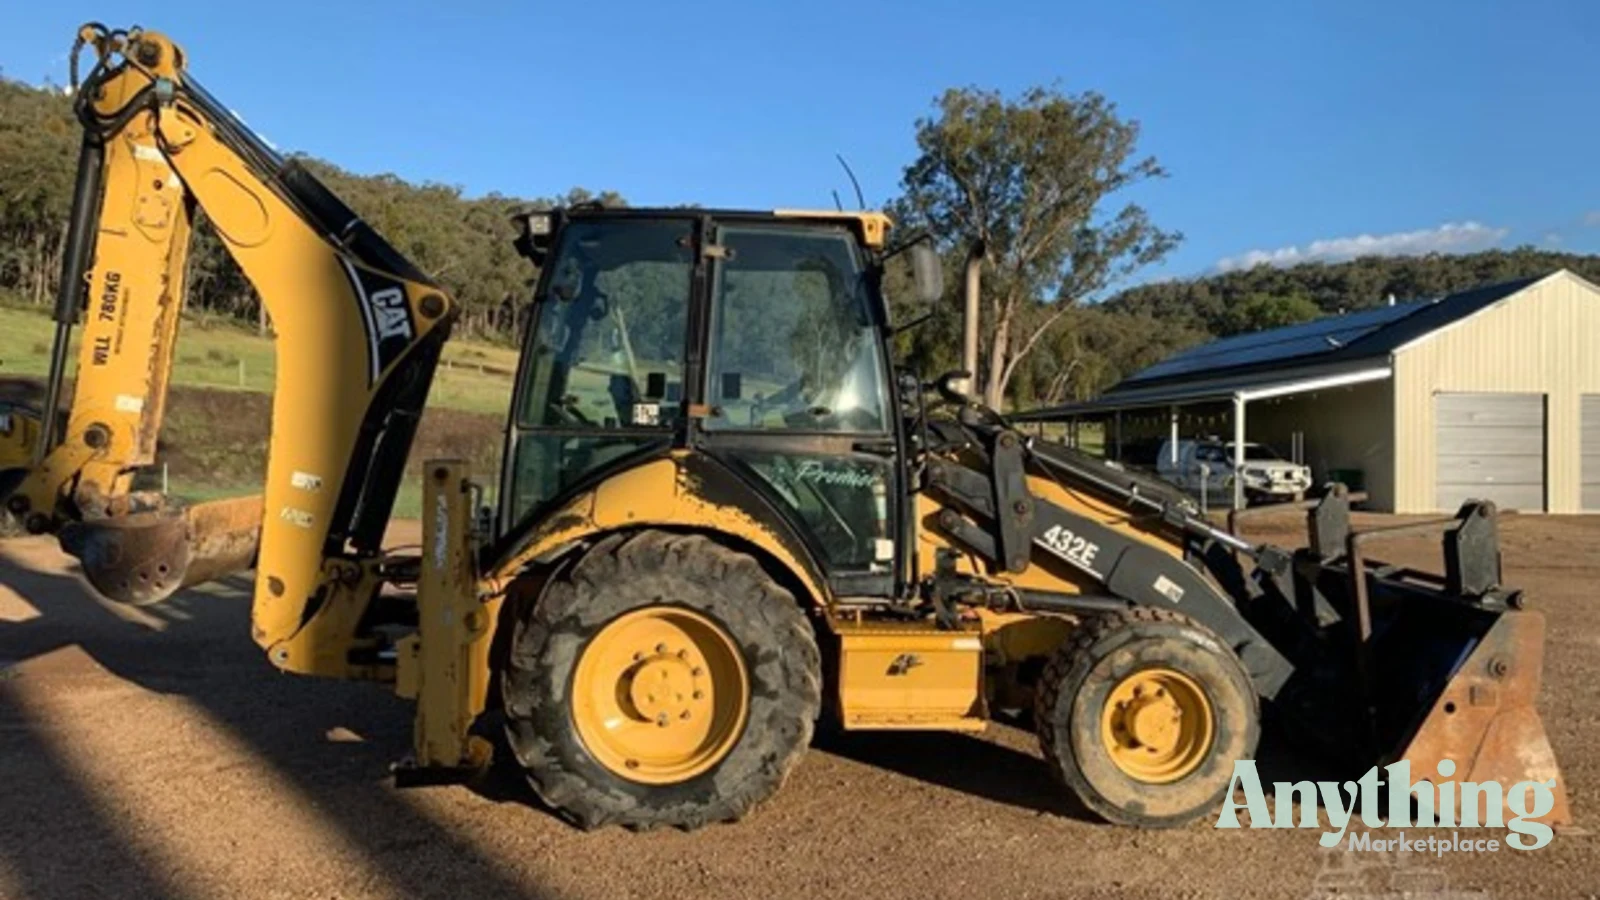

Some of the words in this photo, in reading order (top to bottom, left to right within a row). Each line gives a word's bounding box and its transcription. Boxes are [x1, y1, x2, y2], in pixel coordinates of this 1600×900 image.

[99, 271, 121, 321] 780KG
[371, 287, 412, 341] CAT
[93, 337, 111, 365] WLL
[1043, 524, 1100, 567] 432E
